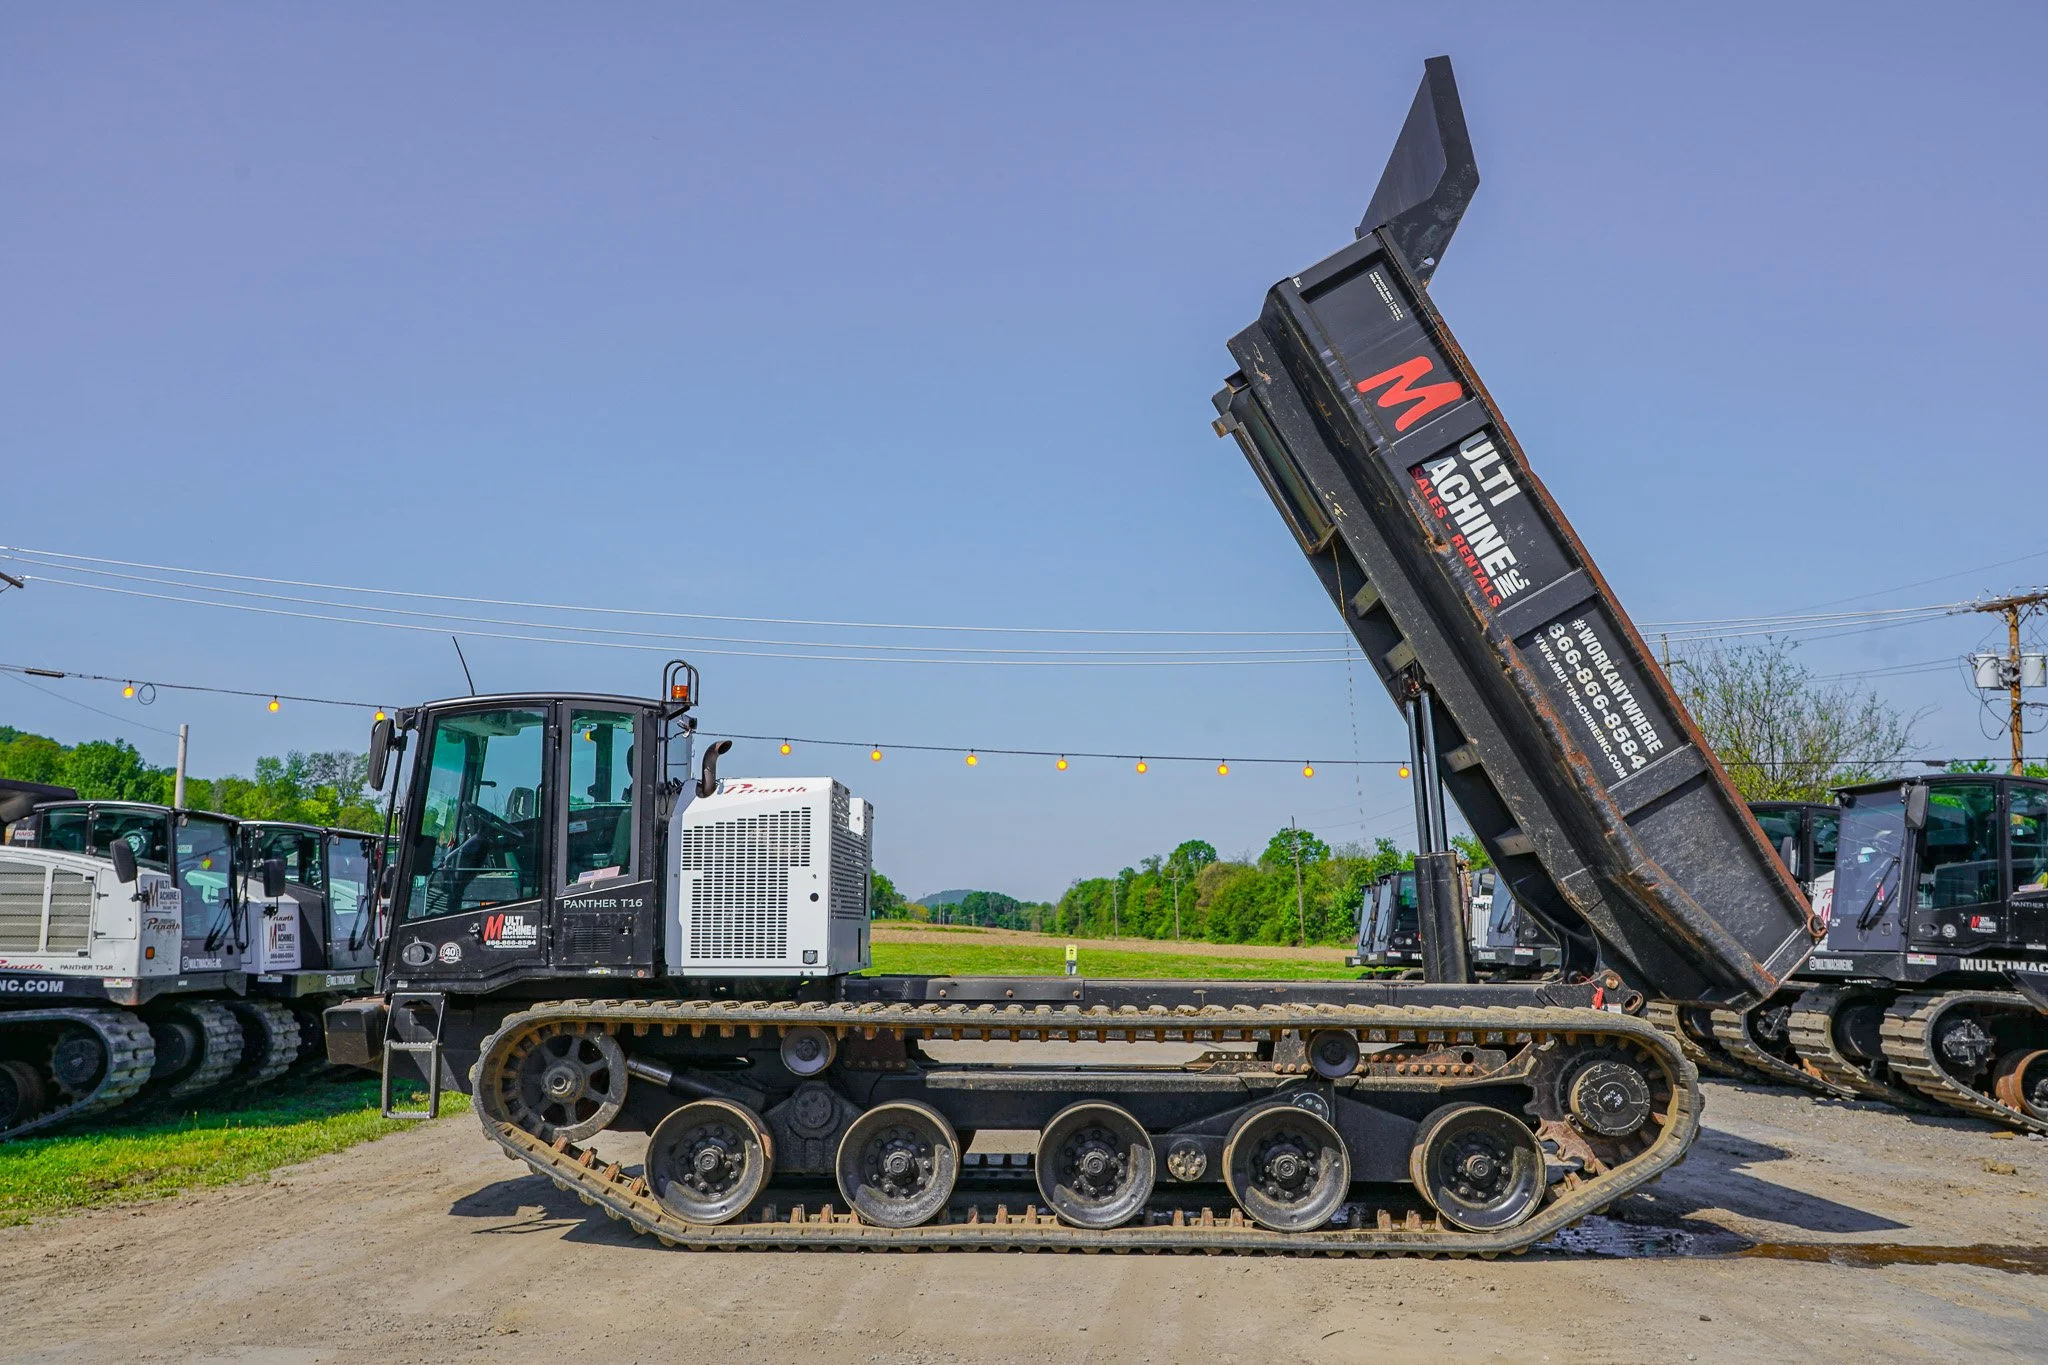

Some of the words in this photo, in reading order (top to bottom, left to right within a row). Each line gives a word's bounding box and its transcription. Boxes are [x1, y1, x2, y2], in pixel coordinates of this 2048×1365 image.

[1411, 466, 1447, 519] SALES
[1451, 533, 1502, 609] RENTALS
[1493, 568, 1530, 599] INC.
[1548, 623, 1648, 770] 866-866-8584
[1572, 618, 1664, 754] #WORKANYWHERE
[563, 899, 617, 908] PANTHER
[620, 899, 643, 908] T16
[2011, 901, 2044, 909] PANTHER
[444, 947, 456, 957] 40
